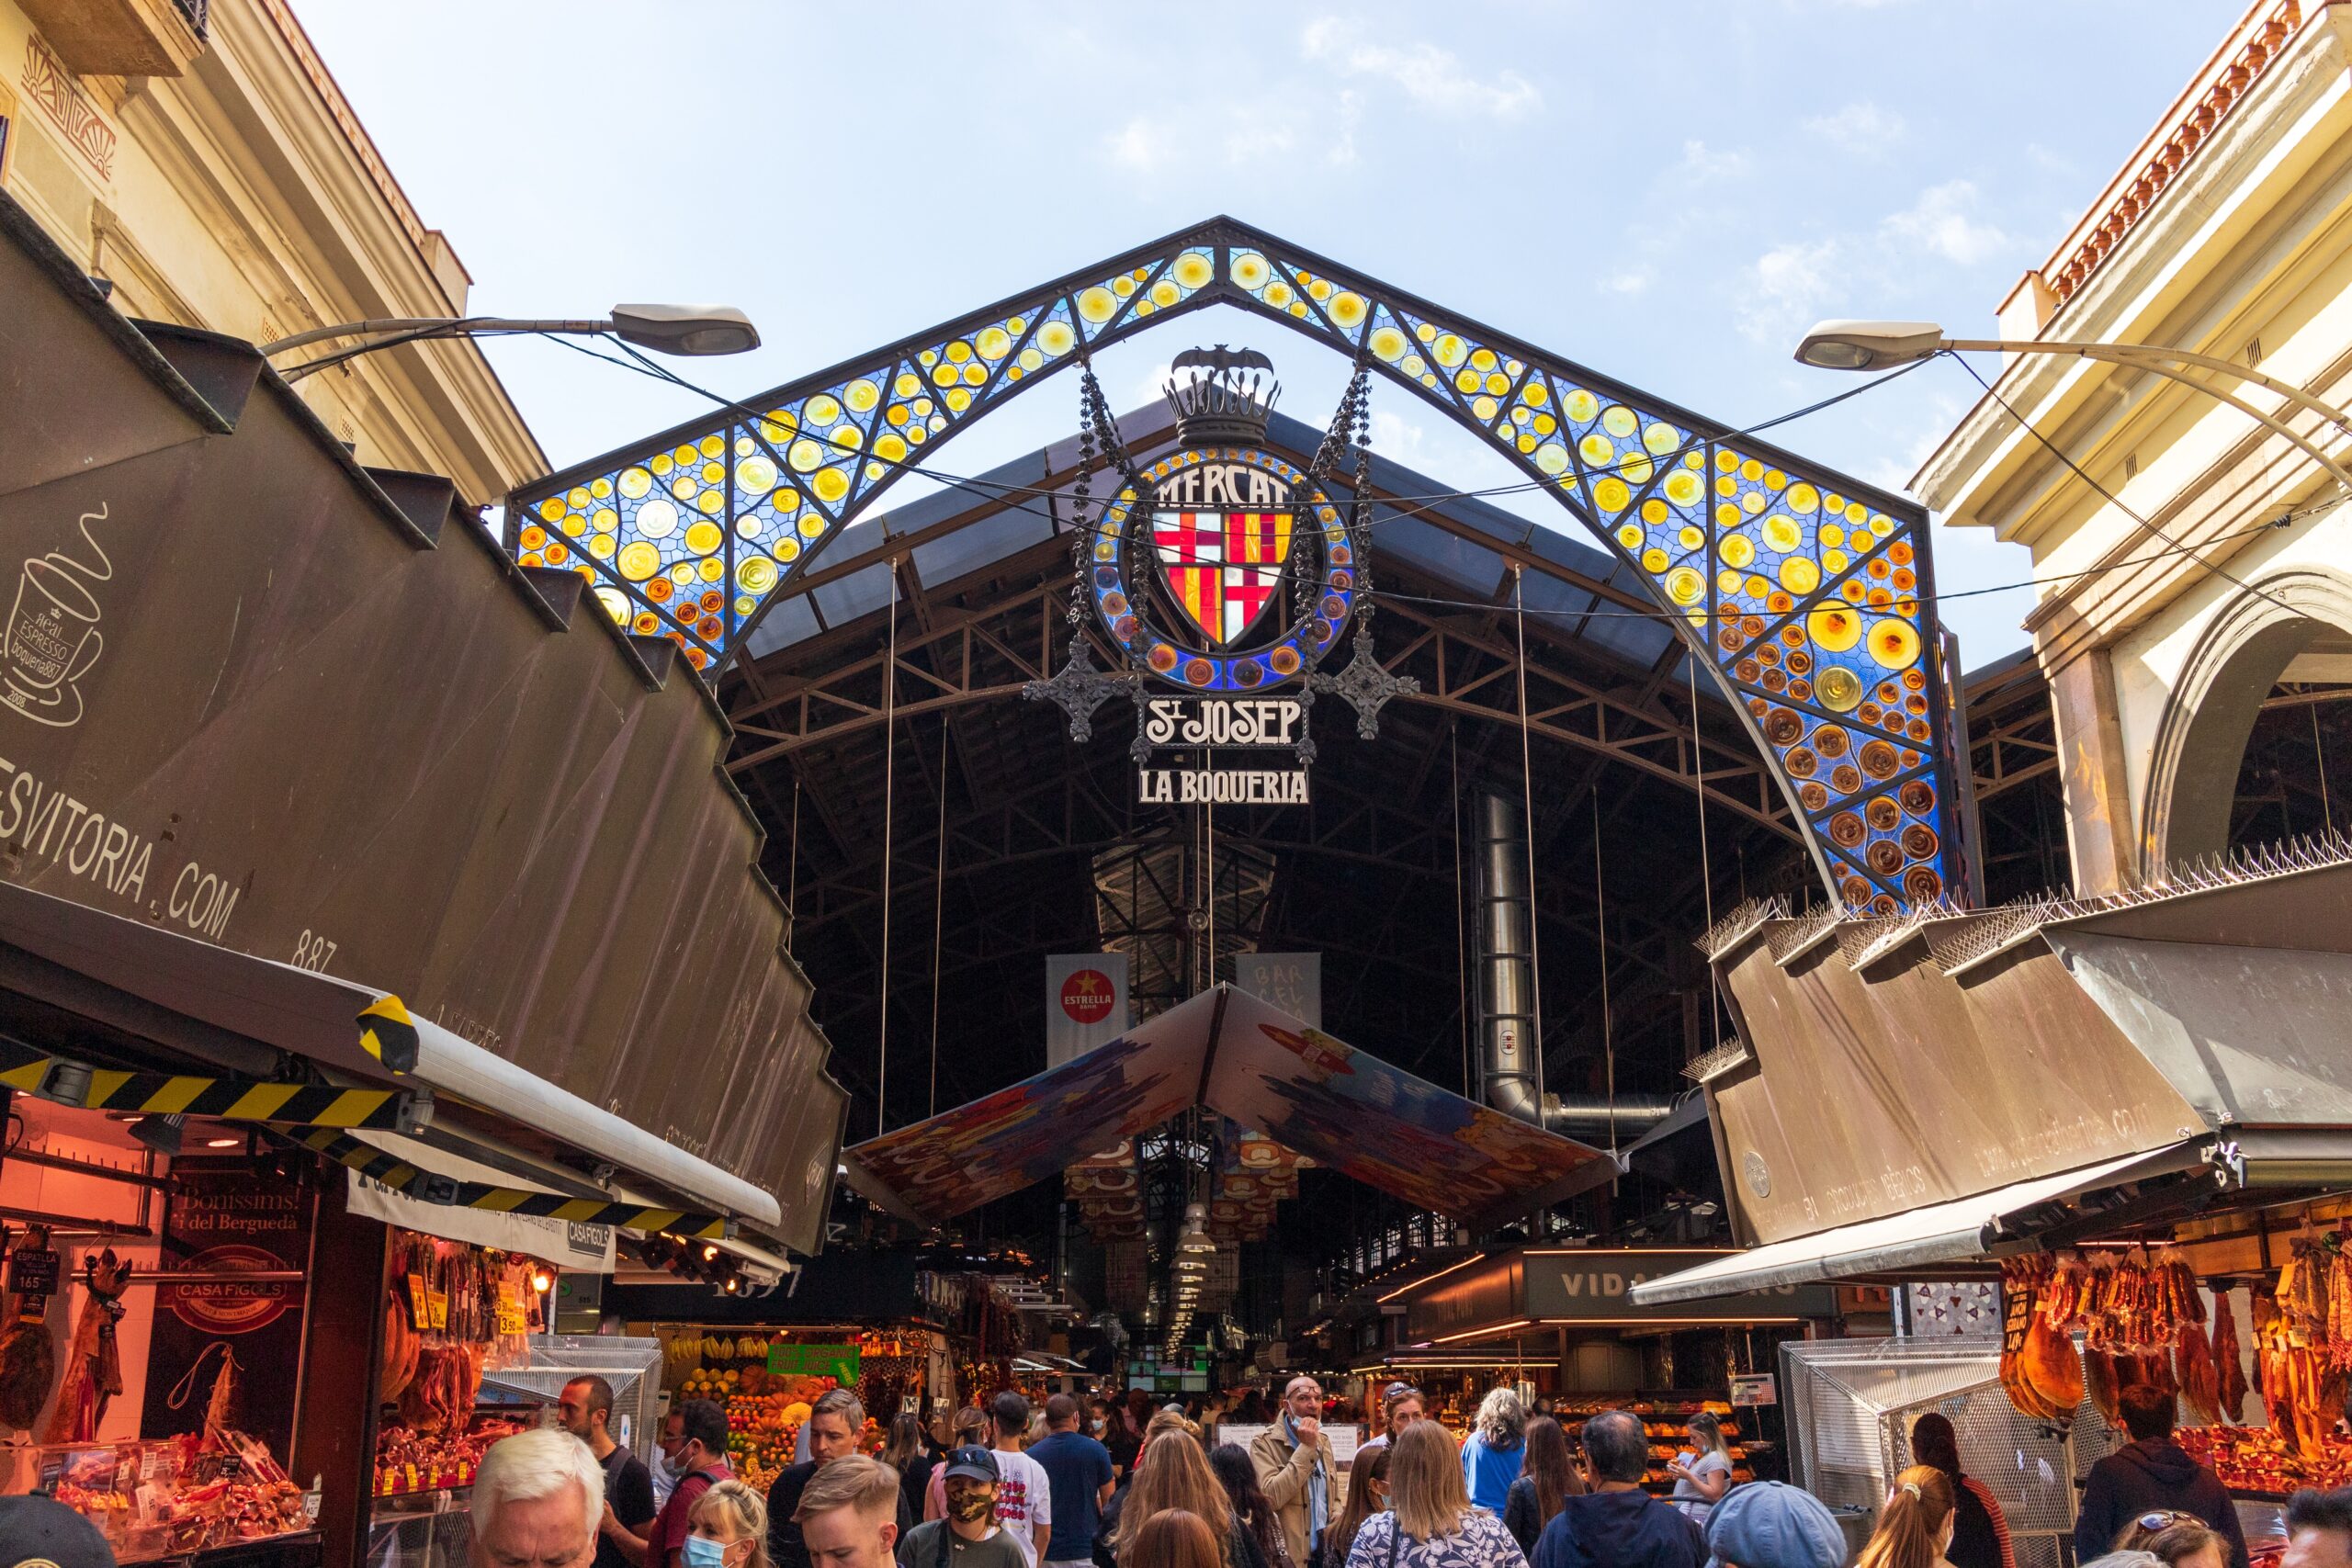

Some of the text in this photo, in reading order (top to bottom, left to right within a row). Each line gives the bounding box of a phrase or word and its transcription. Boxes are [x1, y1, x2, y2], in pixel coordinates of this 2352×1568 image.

[1158, 465, 1289, 509] MERCAT
[19, 620, 67, 660] ESPRESSO
[11, 636, 61, 680] boqueria887
[7, 690, 27, 708] 2008
[1182, 700, 1302, 745] JOSEP
[1140, 770, 1309, 804] LA BOQUERIA
[290, 928, 338, 974] 887
[1065, 995, 1112, 1005] ESTRELLA
[188, 1213, 214, 1230] del
[218, 1214, 298, 1235] Berguedà
[569, 1222, 588, 1243] CASA
[17, 1252, 56, 1263] ESPATLLA
[180, 1284, 221, 1296] CASA
[2006, 1315, 2027, 1333] SERRANO
[804, 1347, 855, 1359] ORGANIC
[772, 1359, 831, 1371] FRUIT JUICE
